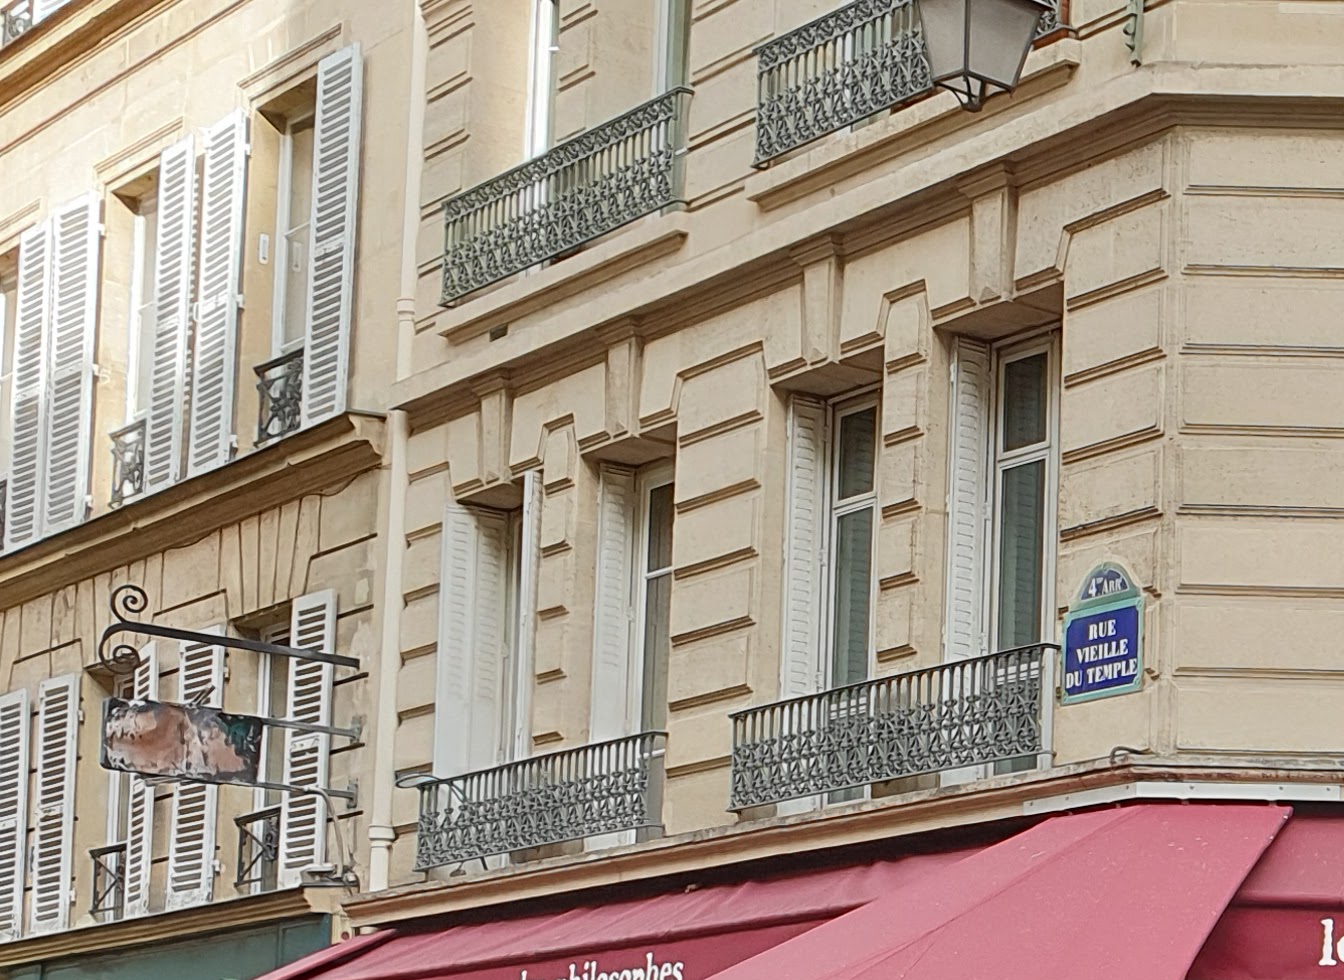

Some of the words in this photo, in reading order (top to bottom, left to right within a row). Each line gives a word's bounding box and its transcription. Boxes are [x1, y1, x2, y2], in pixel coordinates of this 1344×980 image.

[1088, 619, 1117, 641] RUE
[1075, 638, 1129, 665] VIEILLE
[1066, 669, 1084, 689] DU
[1086, 658, 1138, 685] TEMPLE
